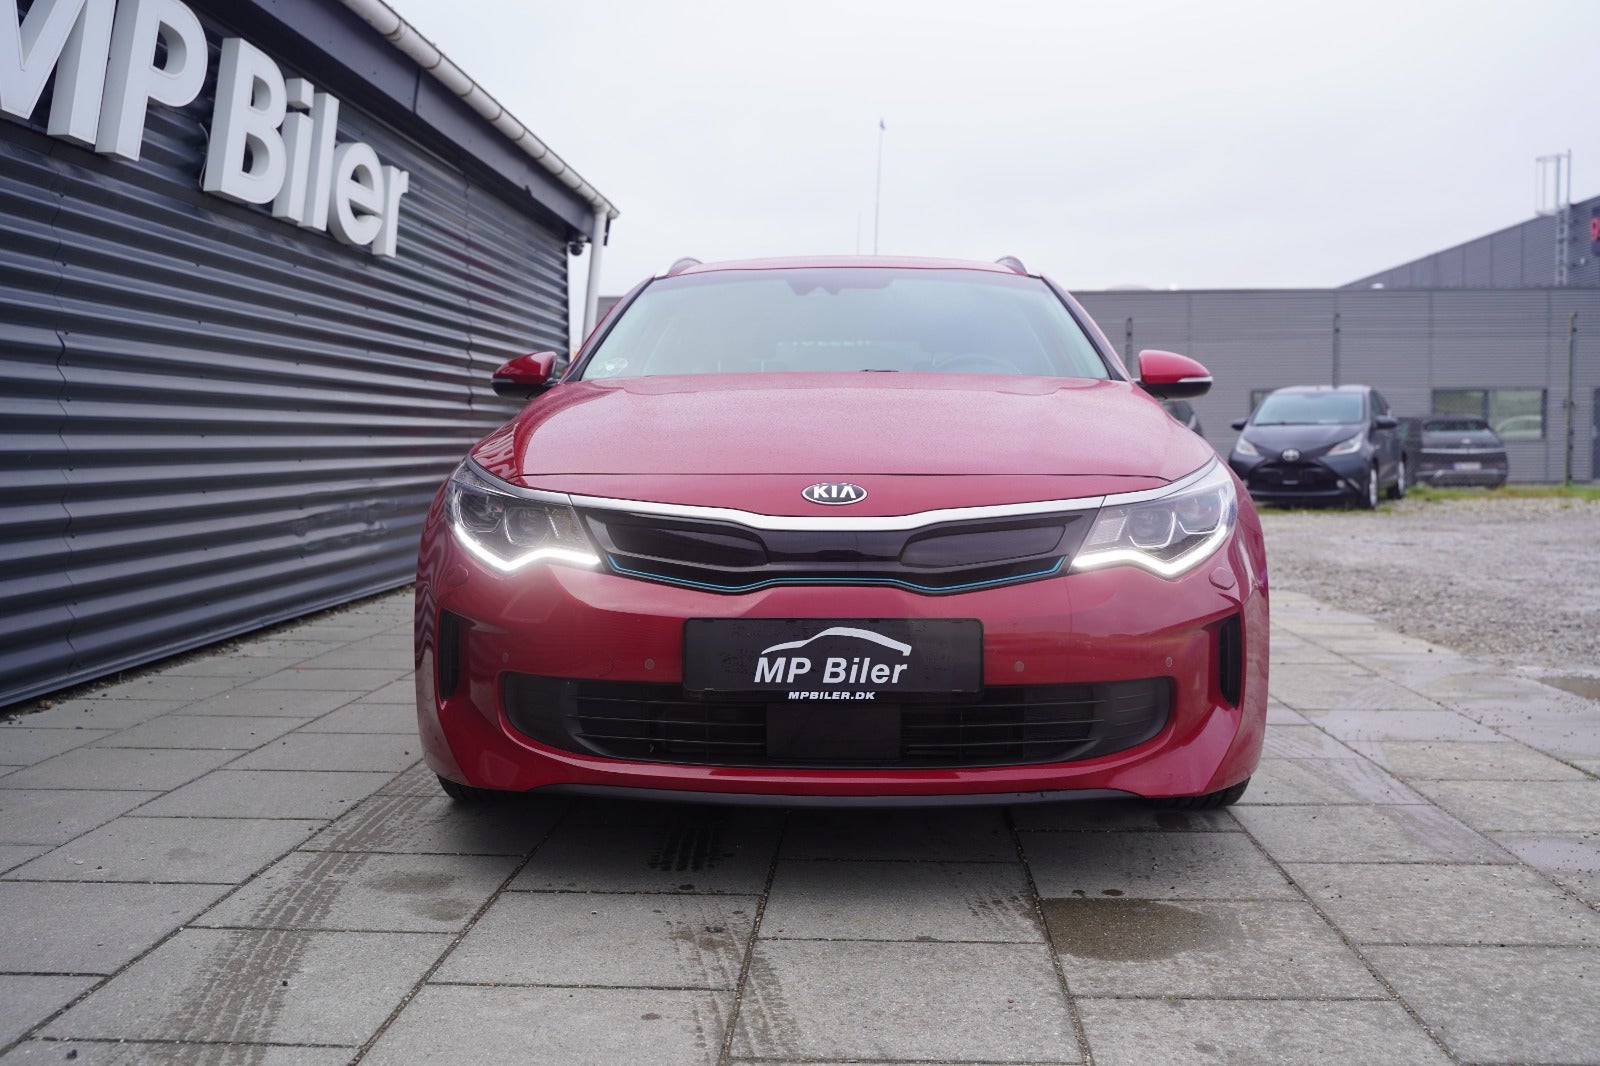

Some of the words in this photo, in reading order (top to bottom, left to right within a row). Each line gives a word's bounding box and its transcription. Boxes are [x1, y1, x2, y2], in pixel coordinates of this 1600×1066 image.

[0, 0, 208, 161] MP
[203, 37, 409, 257] Biler
[813, 485, 857, 499] KIA
[753, 657, 812, 683] MP
[822, 657, 908, 684] Biler
[787, 691, 876, 700] MPBILER.DK
